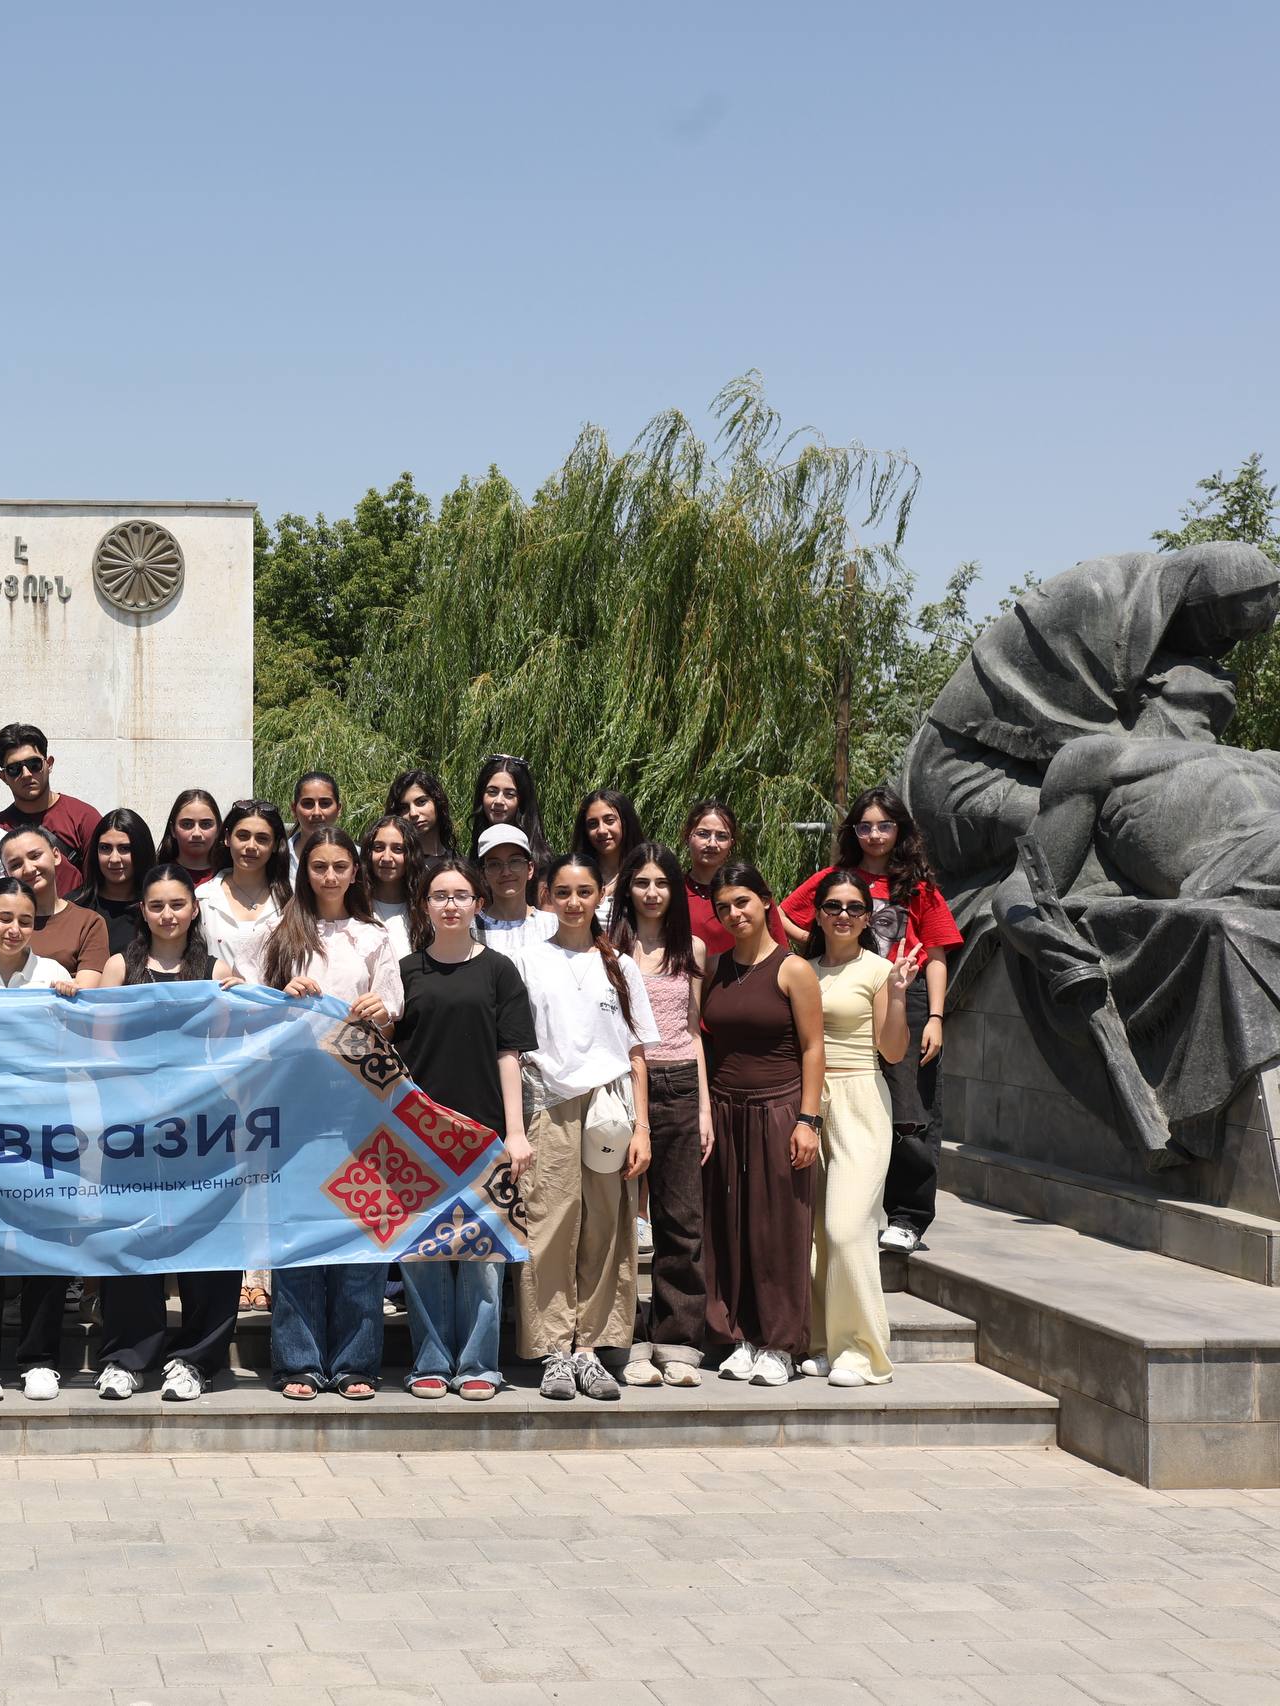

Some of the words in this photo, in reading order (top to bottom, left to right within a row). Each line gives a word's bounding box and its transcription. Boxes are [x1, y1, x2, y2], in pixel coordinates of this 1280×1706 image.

[14, 535, 29, 565] Է
[58, 1179, 188, 1199] традиционных
[190, 1169, 282, 1192] ценностей
